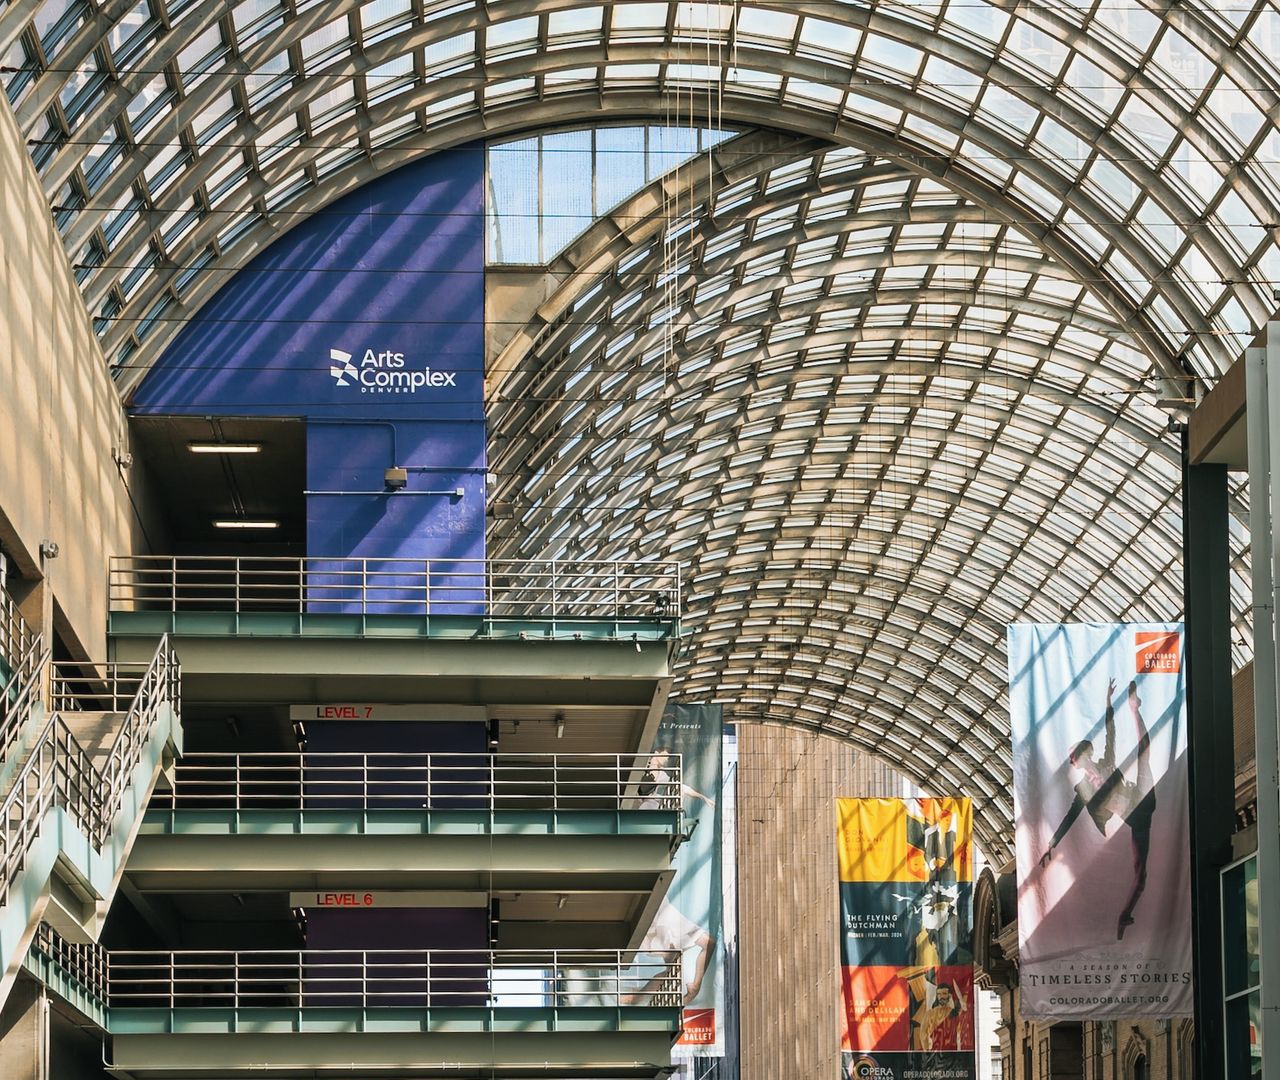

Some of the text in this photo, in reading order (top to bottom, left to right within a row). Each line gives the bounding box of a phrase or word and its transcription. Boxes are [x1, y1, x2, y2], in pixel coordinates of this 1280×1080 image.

[361, 349, 405, 367] Arts
[361, 366, 456, 393] Complex
[1144, 660, 1177, 669] BALLET
[316, 707, 374, 719] LEVEL 7
[316, 894, 373, 906] LEVEL 6
[1082, 963, 1128, 971] SEASON
[1029, 972, 1191, 986] TIMELESS STORIES
[1049, 996, 1169, 1005] COLORADOBALLET.ORG
[683, 1033, 713, 1041] BALLET
[861, 1066, 894, 1077] OPERA
